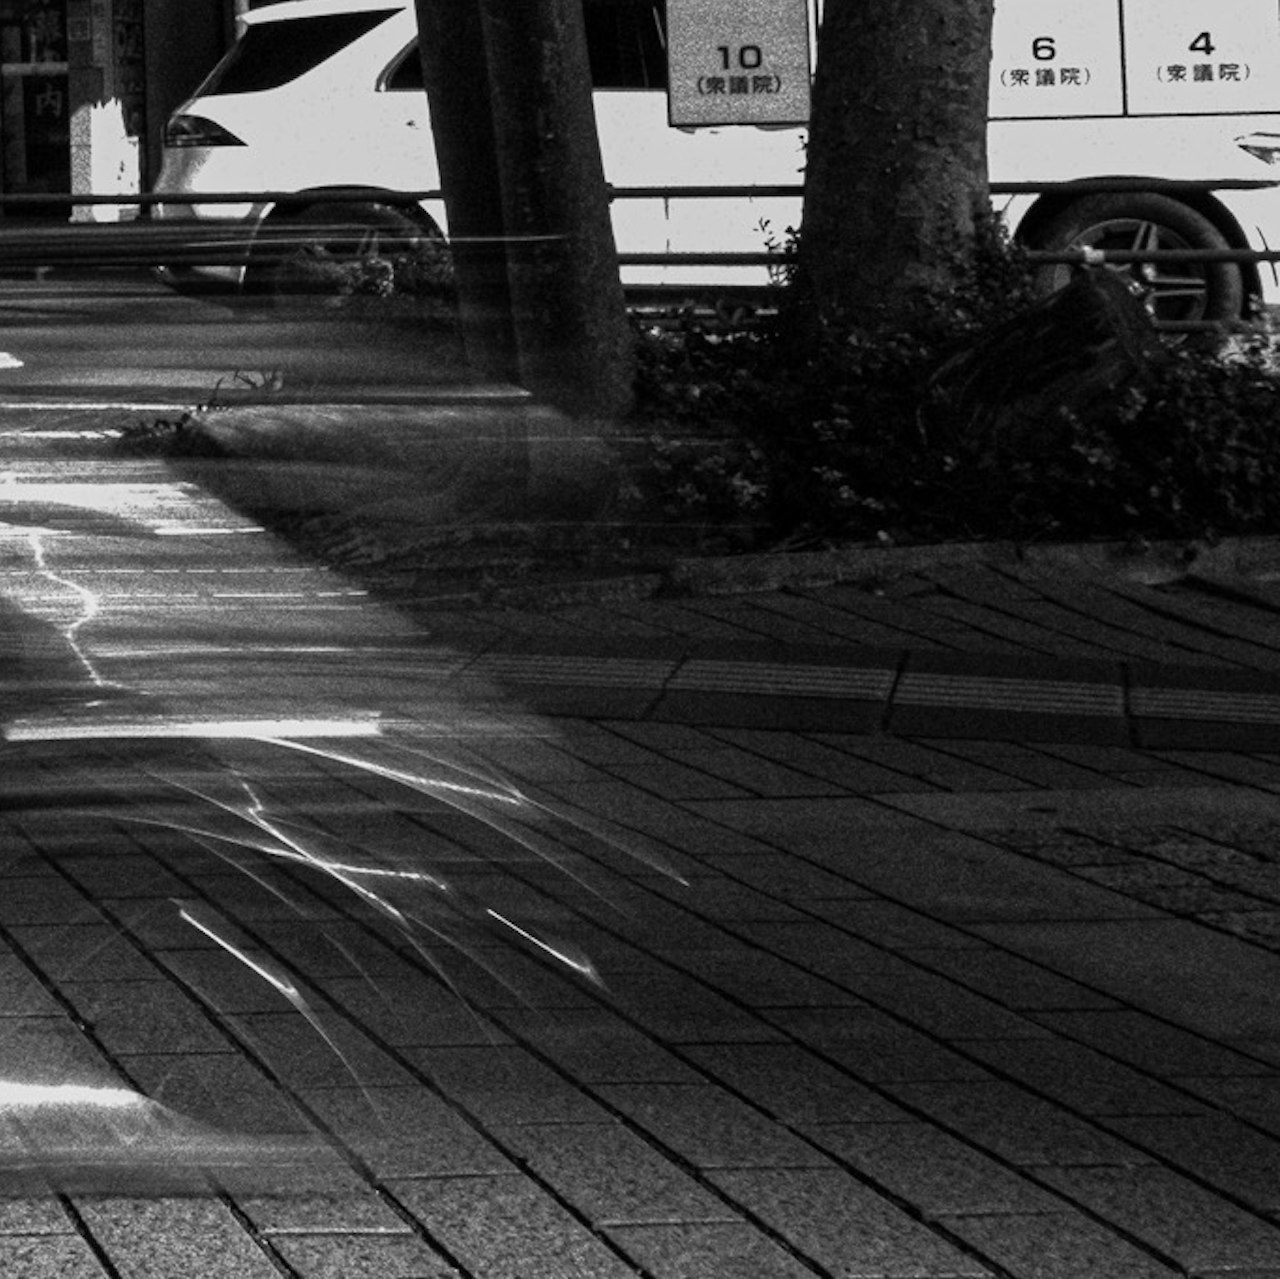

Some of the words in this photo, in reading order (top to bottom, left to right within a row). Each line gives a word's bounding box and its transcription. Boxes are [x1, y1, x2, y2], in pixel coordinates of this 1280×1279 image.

[1031, 36, 1057, 61] 6
[1188, 31, 1216, 56] 4
[716, 44, 763, 70] 10
[1000, 67, 1091, 88] (衆議院)
[1156, 63, 1251, 83] (衆議院)
[698, 75, 782, 96] (衆議院)
